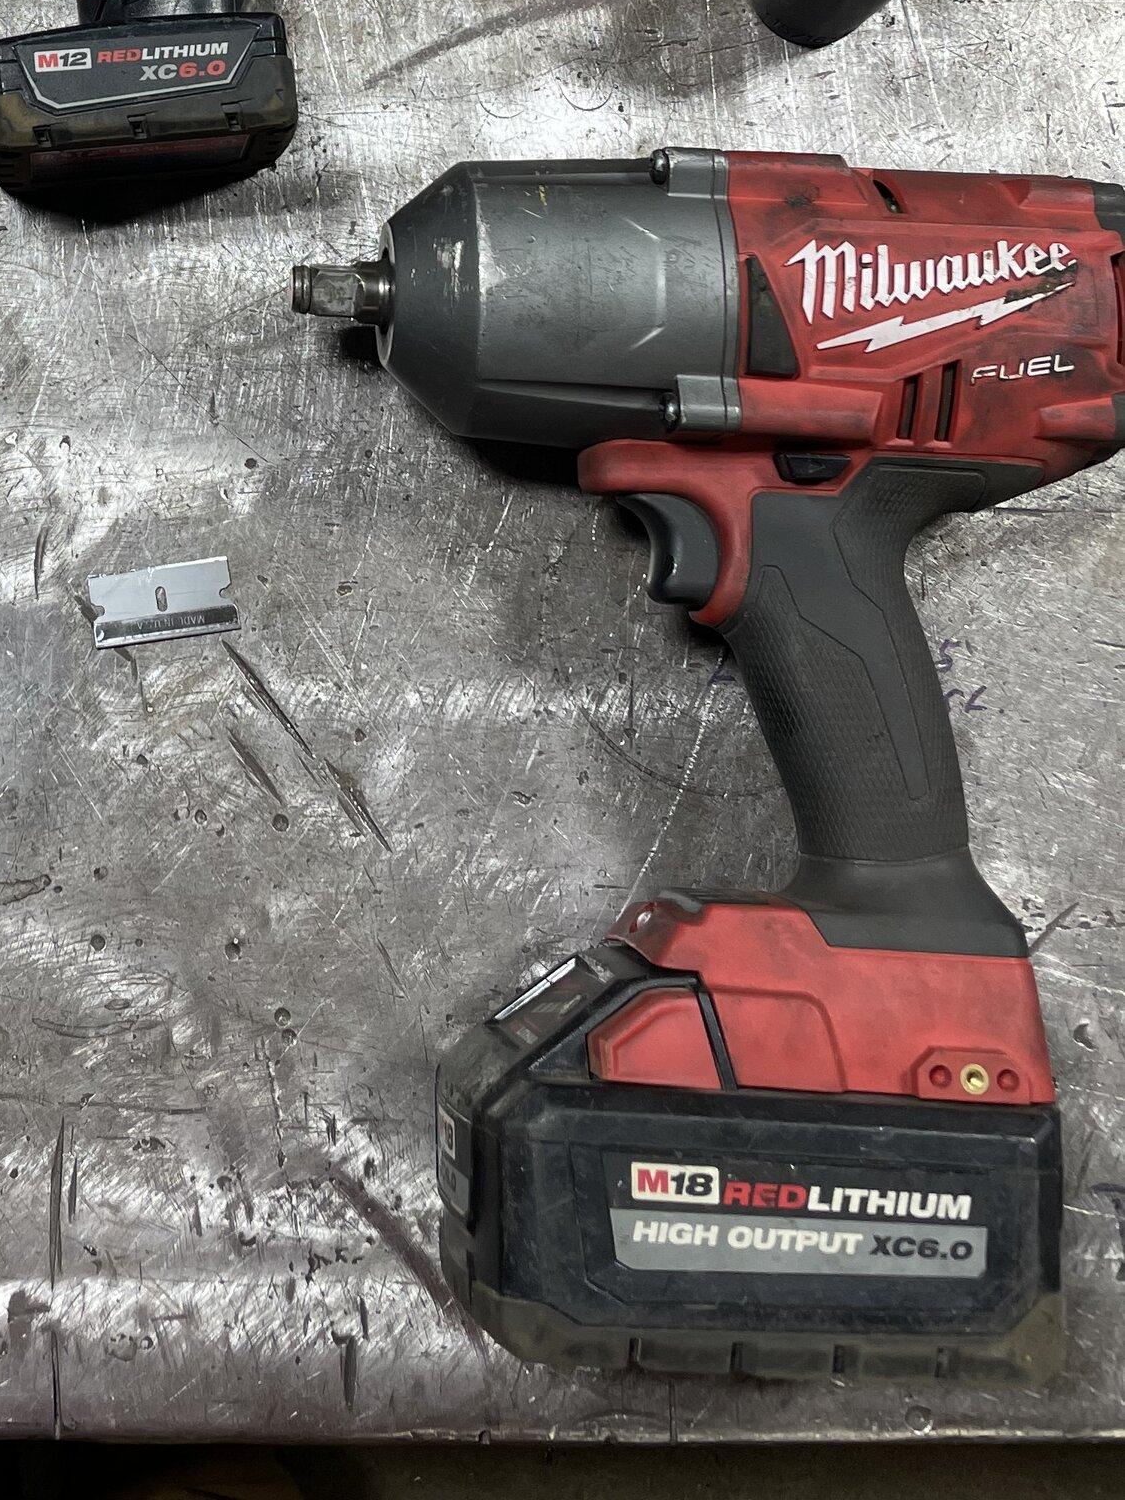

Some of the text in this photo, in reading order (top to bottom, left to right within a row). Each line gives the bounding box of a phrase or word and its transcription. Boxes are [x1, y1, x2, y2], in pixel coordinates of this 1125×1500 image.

[38, 42, 228, 69] M12 REDLITHIUM
[139, 60, 225, 81] XC6.0
[784, 239, 1077, 325] Milwaukee
[971, 355, 1074, 385] FUEL
[636, 1169, 972, 1221] M18 REDLITHIUM
[633, 1220, 973, 1262] HIGH OUTPUT XC6.0
